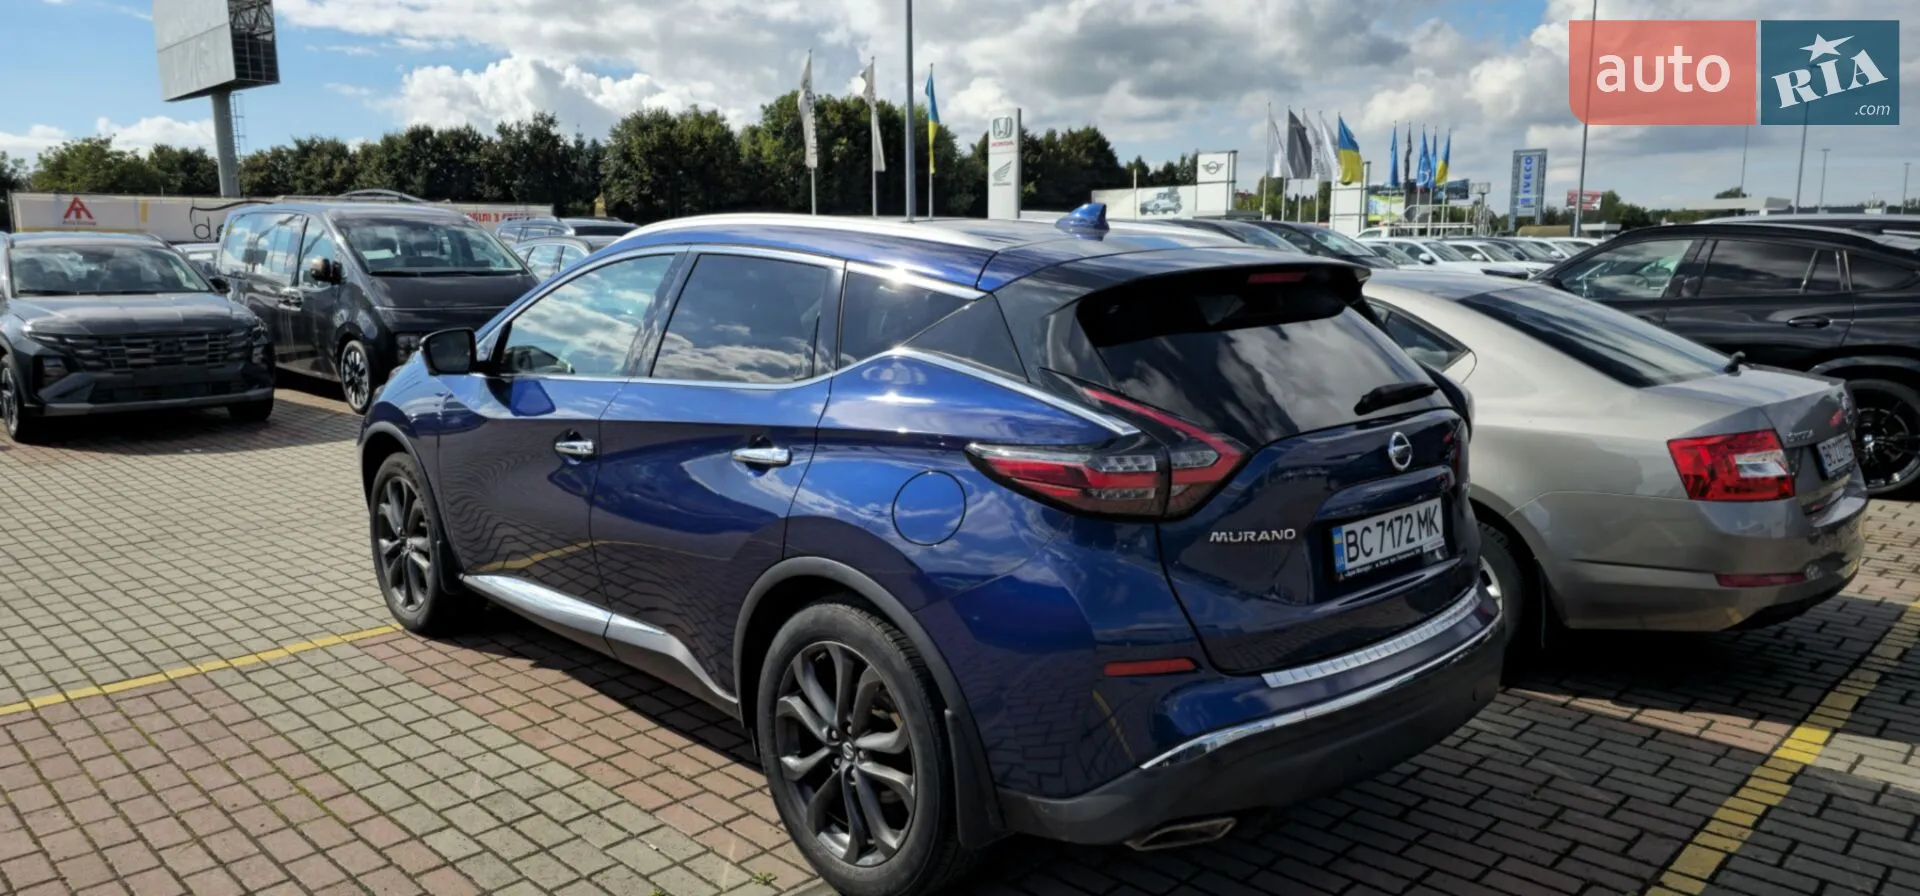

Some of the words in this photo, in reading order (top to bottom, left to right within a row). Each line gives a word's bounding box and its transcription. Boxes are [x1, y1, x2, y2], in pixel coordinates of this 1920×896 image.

[1522, 156, 1533, 194] IVECO
[1209, 528, 1297, 542] MURANO
[1345, 526, 1374, 563] BC
[1376, 513, 1416, 554] 7172
[1417, 504, 1440, 541] MK
